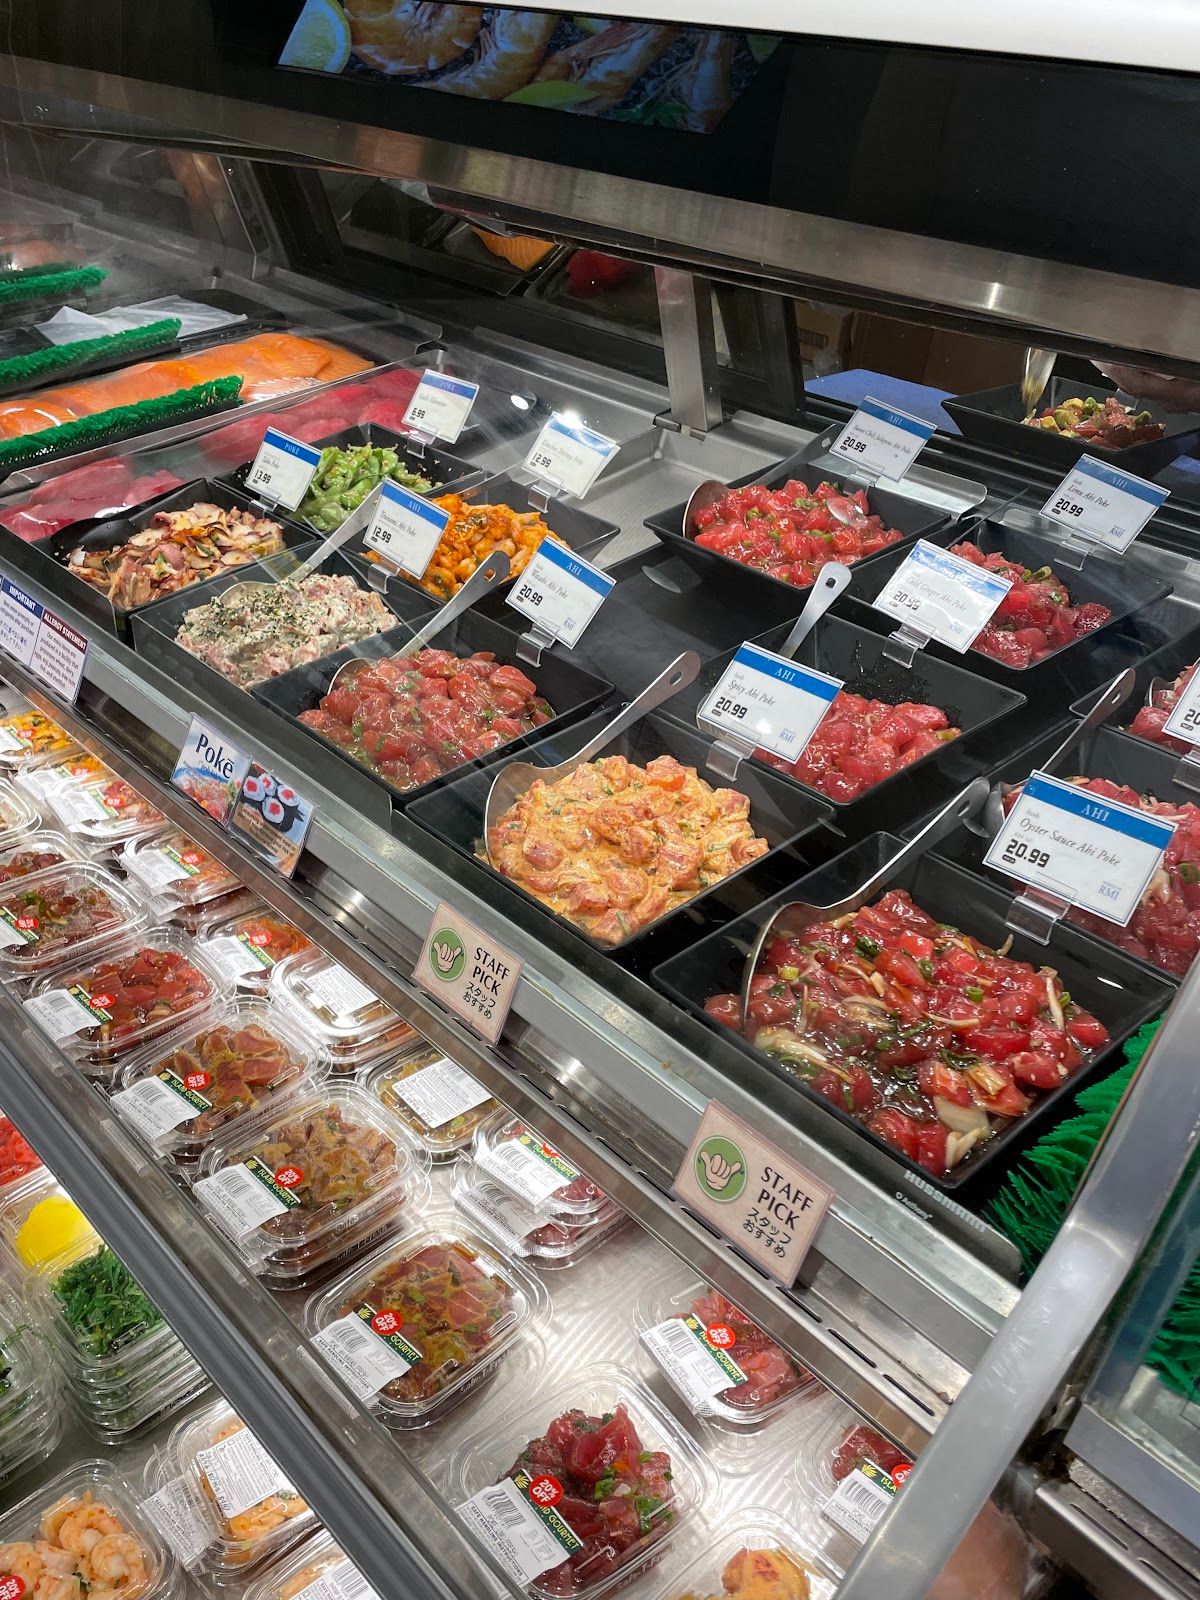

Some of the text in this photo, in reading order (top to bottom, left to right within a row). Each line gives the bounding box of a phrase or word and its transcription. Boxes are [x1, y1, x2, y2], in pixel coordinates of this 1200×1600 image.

[411, 407, 426, 419] 6.99
[887, 415, 903, 426] AHI
[284, 443, 300, 456] POKE
[842, 436, 867, 453] 20.99
[532, 452, 552, 468] 12.99
[254, 468, 272, 484] 13.99
[1110, 476, 1128, 489] AHI
[407, 501, 421, 513] AHI
[1054, 497, 1084, 518] 20.99
[1083, 493, 1096, 504] Ahi
[1094, 496, 1111, 509] Poke
[372, 524, 392, 544] 12.99
[406, 525, 417, 538] Poke
[1108, 527, 1124, 538] RMI
[566, 562, 582, 577] AHI
[531, 568, 569, 600] Wasabi Ahi Poke
[9, 585, 37, 611] IMPORTANT
[519, 584, 543, 607] 20.99
[893, 590, 920, 611] 20.99
[919, 583, 941, 598] Ginger
[940, 593, 953, 603] Ahi
[952, 599, 967, 612] Poke
[43, 612, 87, 651] ALLERGY STATEMENT
[774, 667, 797, 682] AHI
[728, 680, 776, 707] Spicy Ahi Poke
[715, 696, 749, 719] 20.99
[778, 731, 797, 743] RMI
[1081, 804, 1110, 822] AHI
[1018, 816, 1120, 866] Oyster Sauce Ahi Poke
[1004, 838, 1051, 868] 20.99
[1097, 884, 1120, 902] RMI
[473, 947, 510, 980] STAFF
[471, 965, 502, 996] PICK
[462, 991, 492, 1019] おすすめ
[466, 981, 496, 1008] スタッフ
[171, 1079, 209, 1109] ISLAND GOURMET
[284, 1169, 300, 1181] 20%
[550, 1157, 577, 1179] GOURMET
[258, 1168, 297, 1206] ISLAND GOURMET
[277, 1174, 294, 1186] OFF
[760, 1166, 814, 1211] STAFF
[757, 1188, 800, 1230] PICK
[747, 1207, 792, 1244] スタッフ
[743, 1219, 785, 1258] おすすめ
[375, 1317, 389, 1332] OFF
[383, 1312, 398, 1330] 20%
[709, 1329, 721, 1344] OFF
[717, 1327, 729, 1345] 20%
[390, 1335, 420, 1361] GOURMET
[327, 1346, 345, 1364] HANDLING
[344, 1362, 370, 1389] INSTRUCTIONS
[716, 1350, 744, 1381] GOURMET
[532, 1487, 552, 1504] OFF
[539, 1479, 559, 1499] 20%
[471, 1505, 523, 1577] SAFE HANDLING INSTRUCTIONS
[548, 1515, 580, 1550] GOURMET
[6, 1578, 21, 1597] 20%
